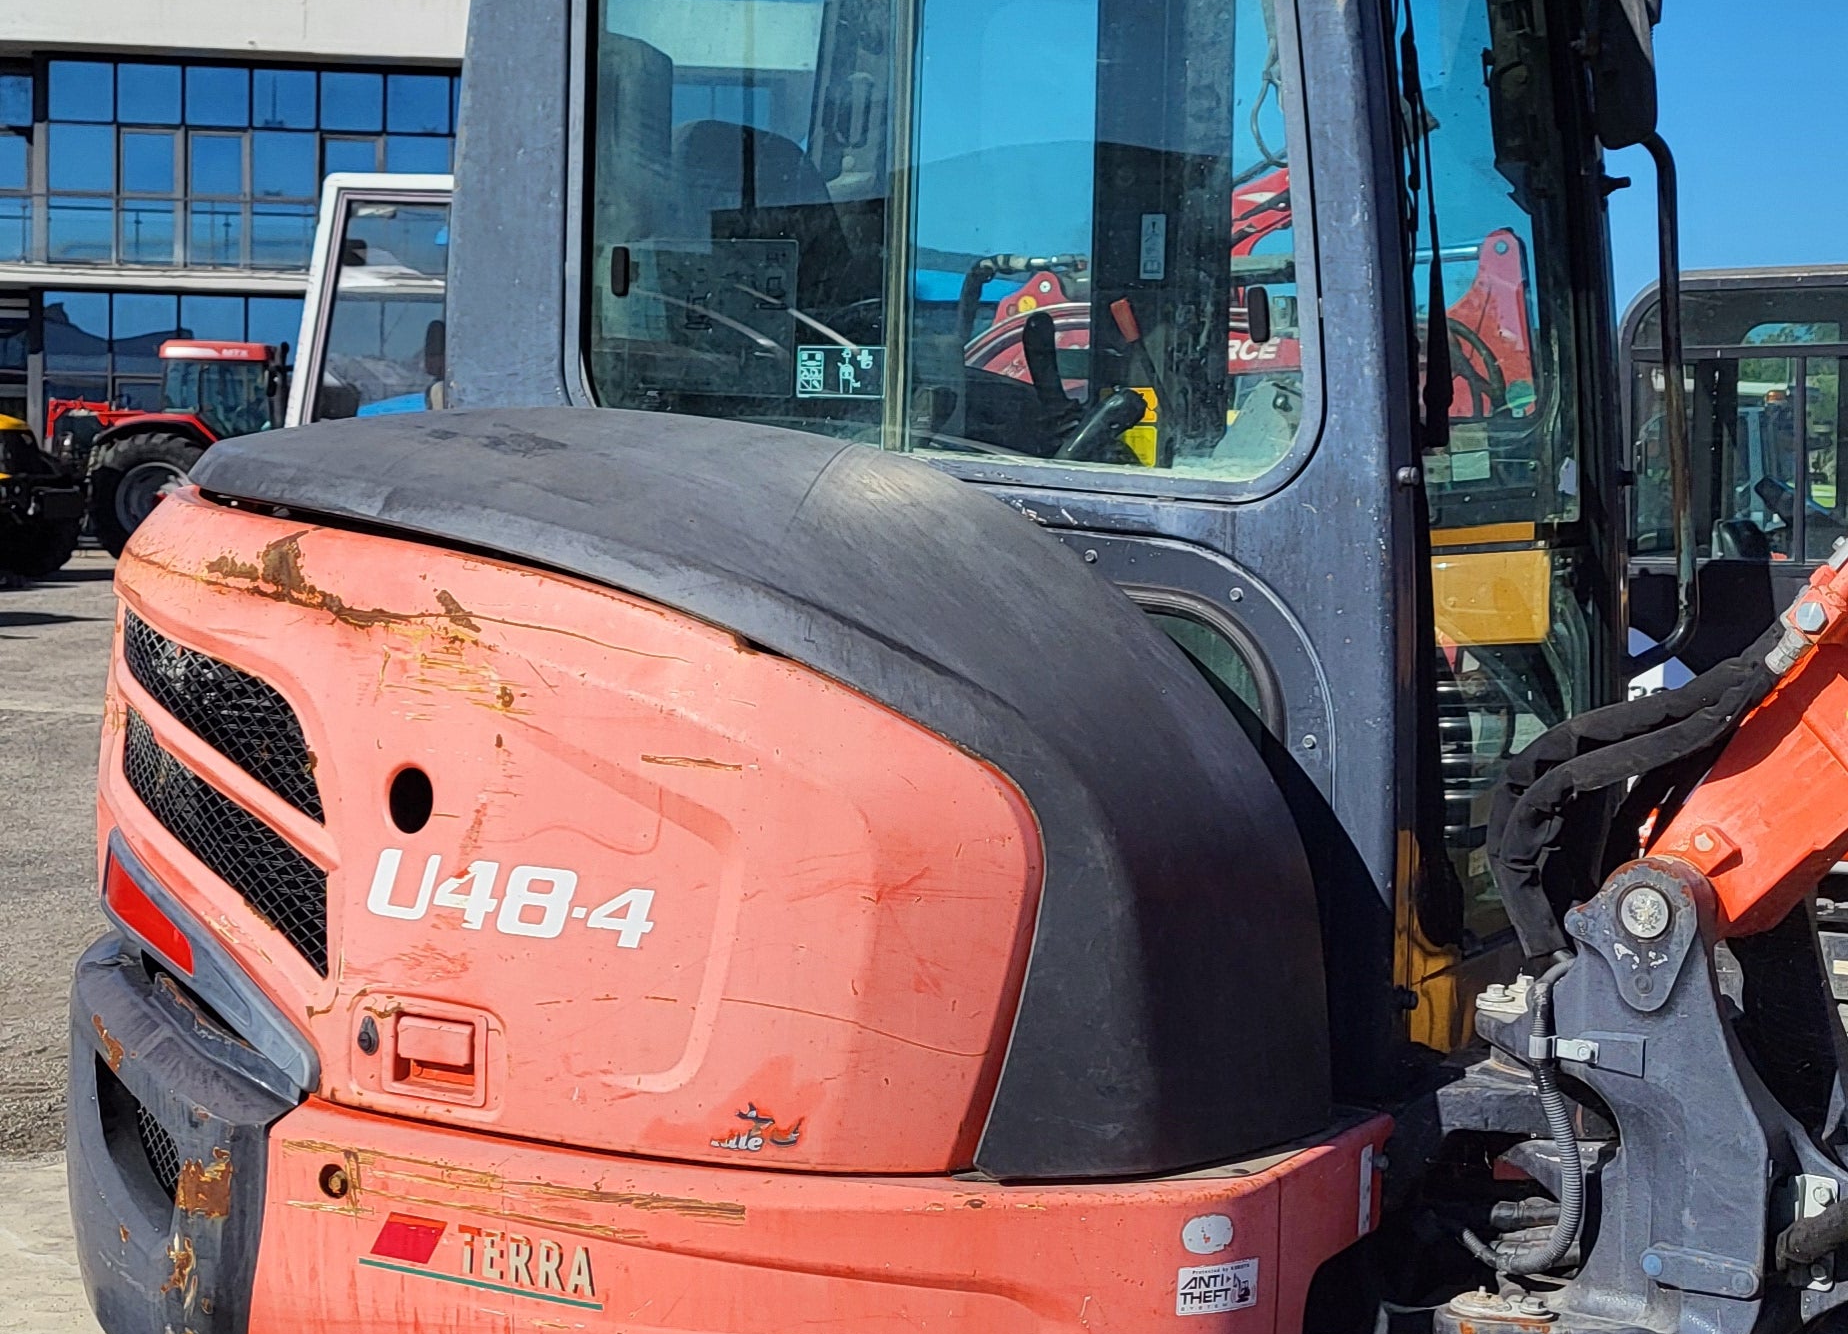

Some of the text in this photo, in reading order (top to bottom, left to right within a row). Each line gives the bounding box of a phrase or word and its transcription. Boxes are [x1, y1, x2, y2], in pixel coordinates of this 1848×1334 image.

[367, 848, 656, 949] U48-4
[458, 1224, 596, 1297] TERRA
[1180, 1288, 1232, 1306] THEFT
